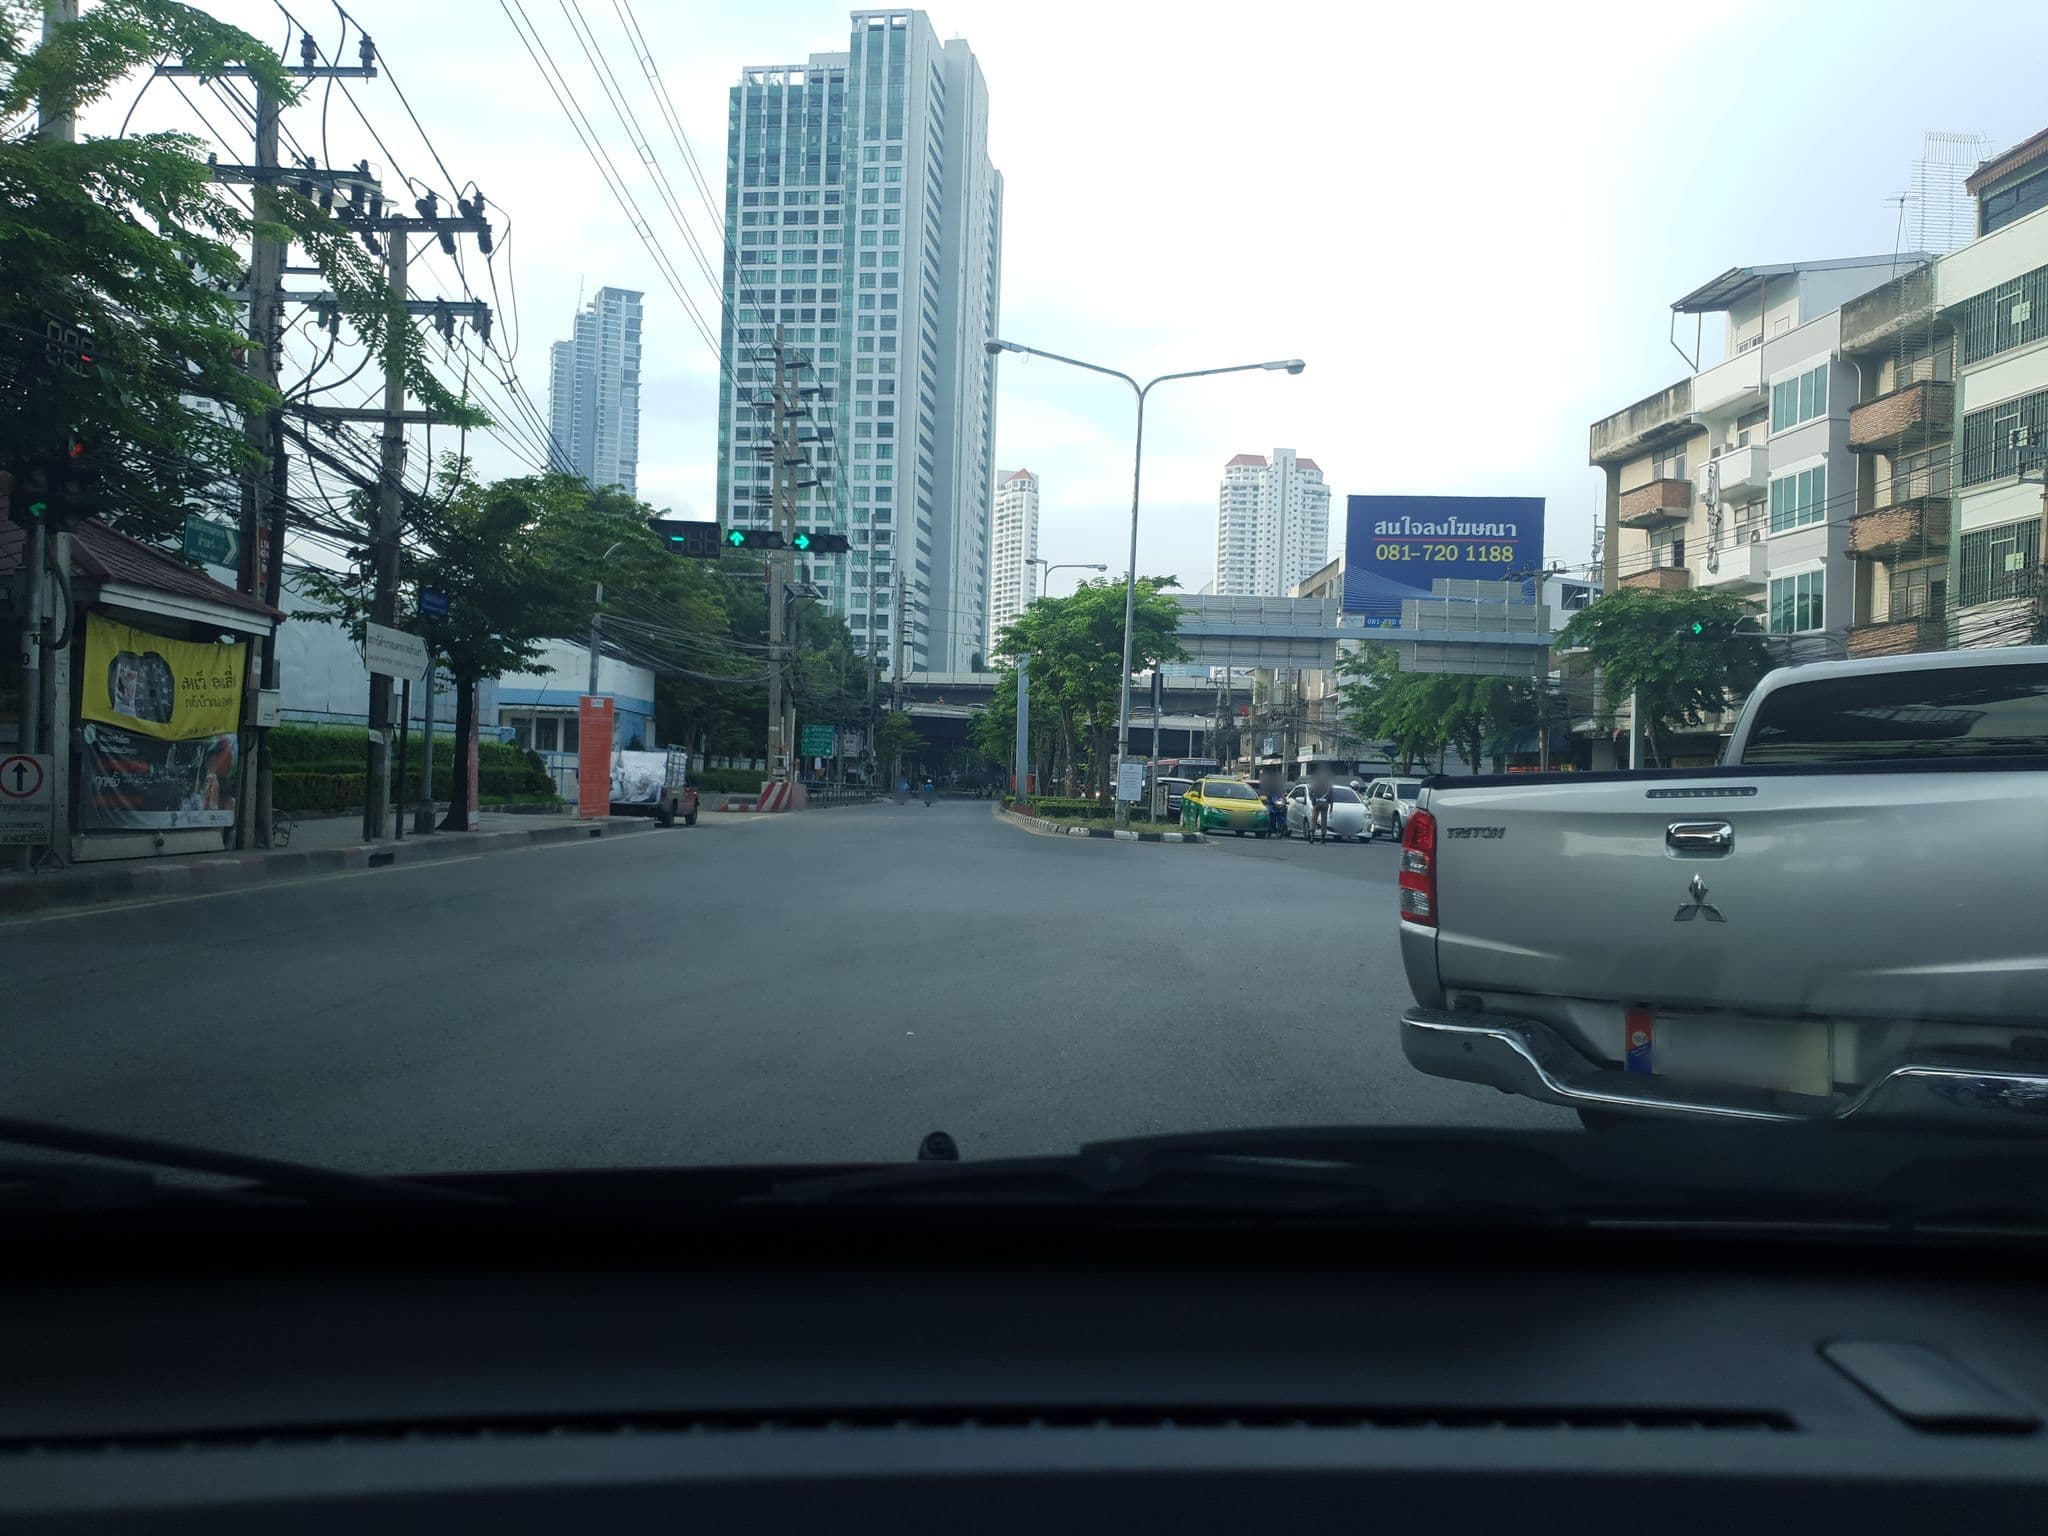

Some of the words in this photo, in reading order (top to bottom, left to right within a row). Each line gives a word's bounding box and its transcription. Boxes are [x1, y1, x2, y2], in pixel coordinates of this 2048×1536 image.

[1374, 515, 1517, 537] สนใจลงโฆษณา
[1375, 544, 1459, 561] 081-720
[1466, 545, 1514, 563] 1188
[1446, 826, 1506, 839] TRITON
